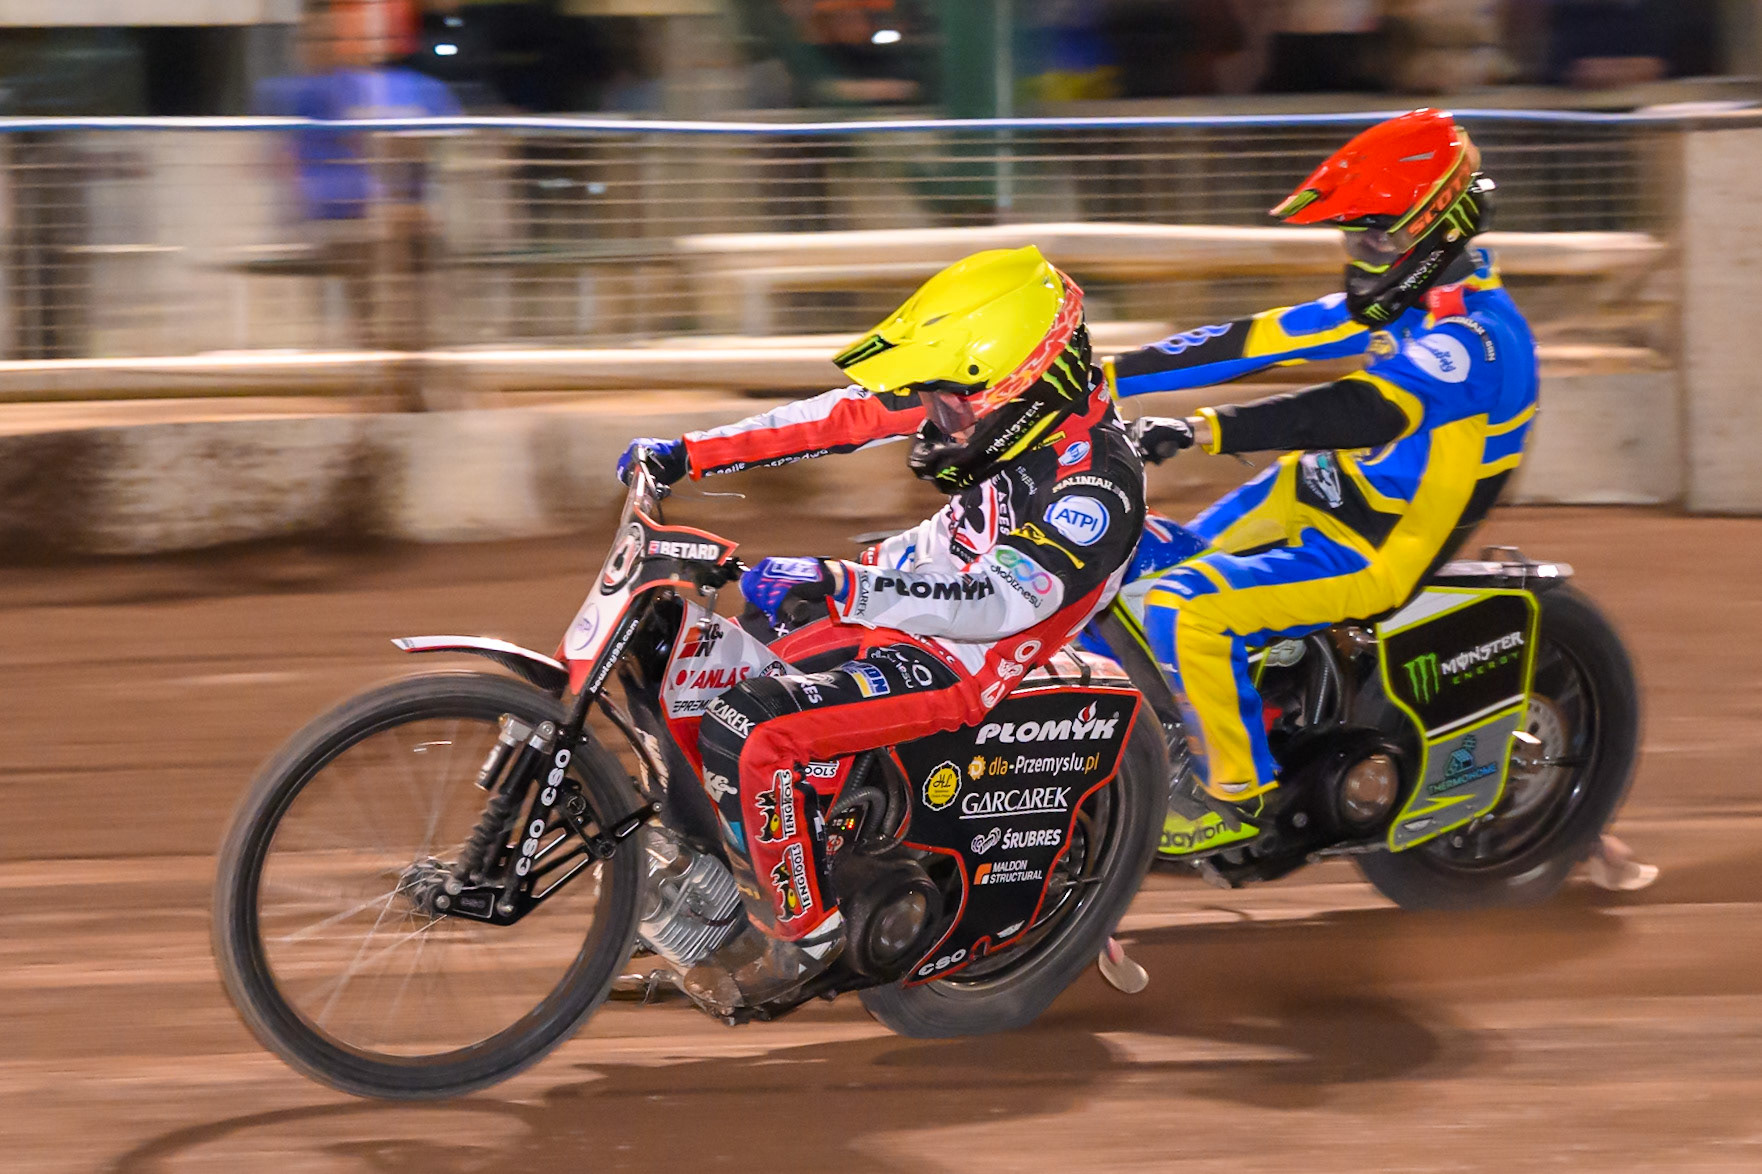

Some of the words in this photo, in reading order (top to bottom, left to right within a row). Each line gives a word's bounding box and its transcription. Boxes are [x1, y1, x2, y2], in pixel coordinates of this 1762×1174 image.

[985, 400, 1045, 455] MONSTER
[1055, 508, 1098, 532] ATPI
[660, 542, 720, 560] BETARD
[1441, 631, 1525, 675] MONSTER
[804, 766, 837, 777] OOLS
[961, 786, 1072, 815] GARCAREK
[1001, 828, 1062, 850] ŚRUBRES
[990, 870, 1043, 884] STRUCTURAL
[992, 860, 1028, 873] MALDON
[918, 948, 967, 976] CSO
